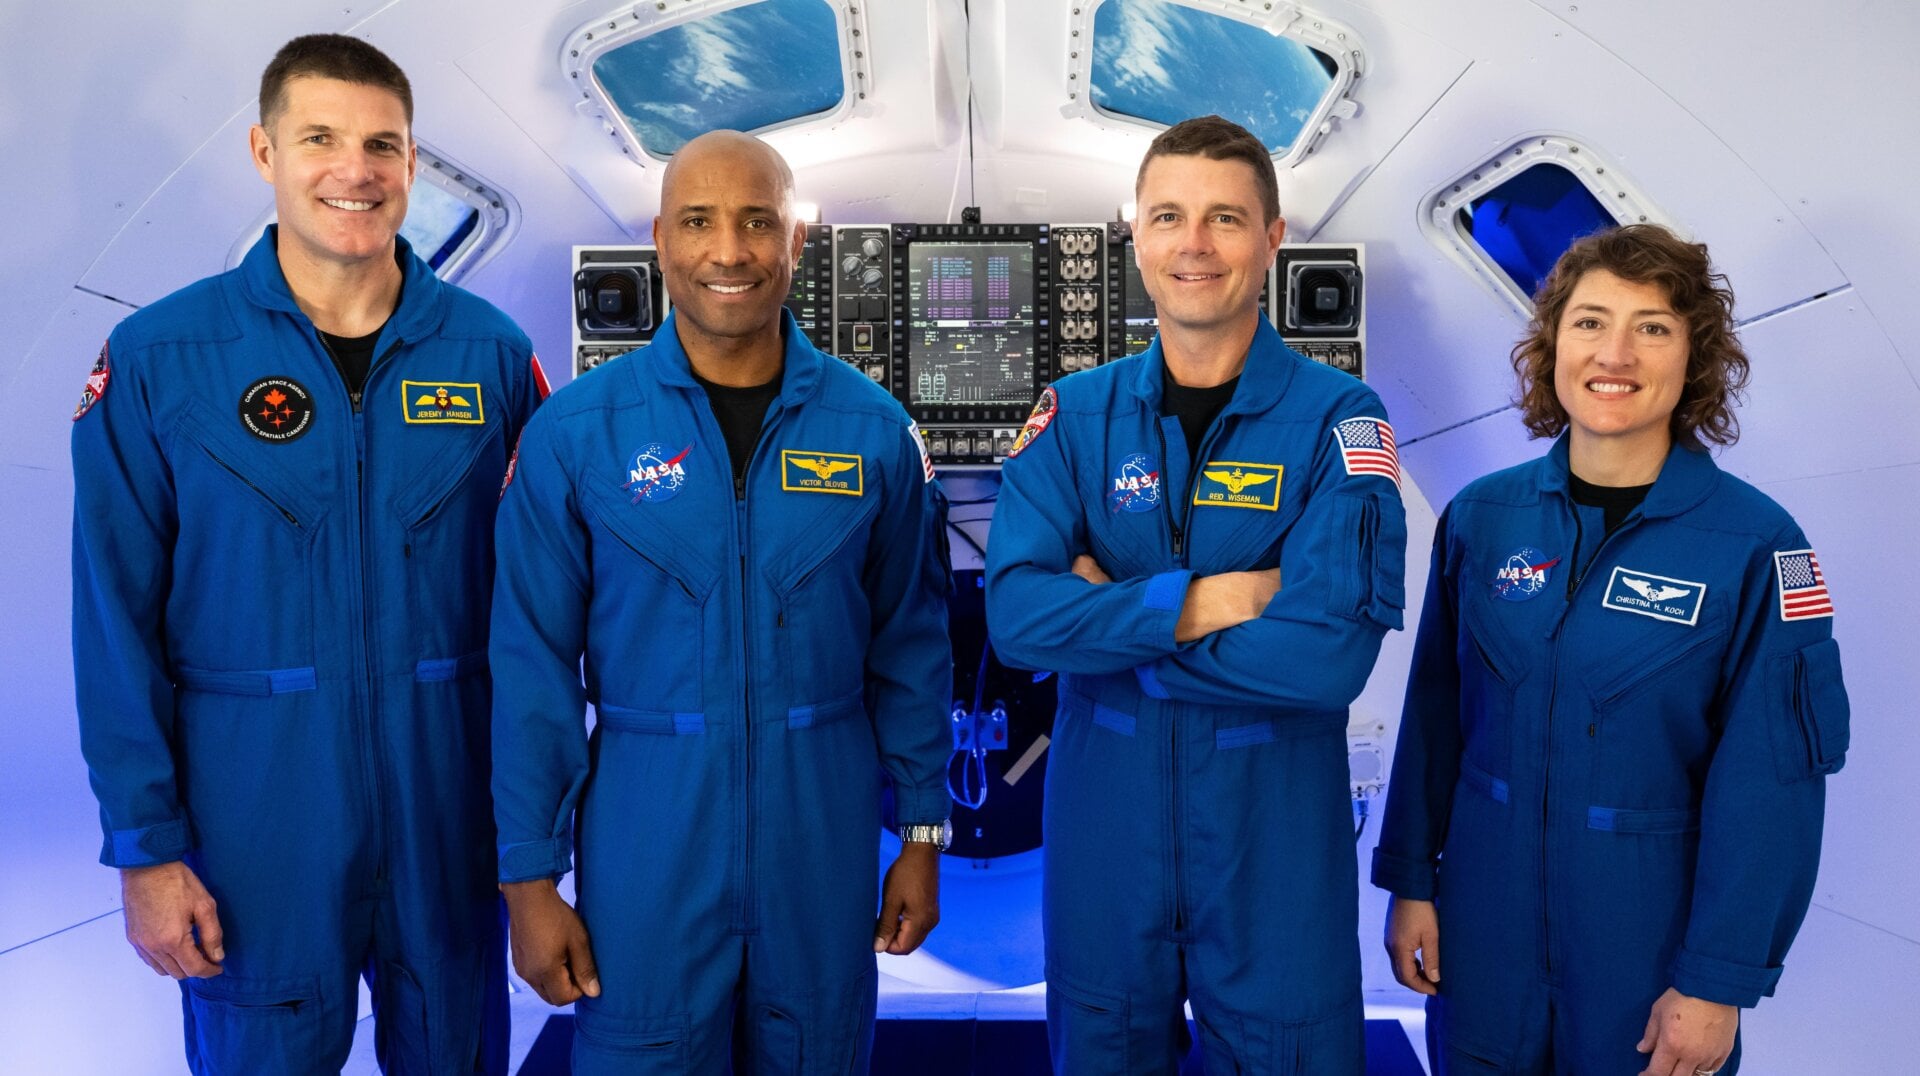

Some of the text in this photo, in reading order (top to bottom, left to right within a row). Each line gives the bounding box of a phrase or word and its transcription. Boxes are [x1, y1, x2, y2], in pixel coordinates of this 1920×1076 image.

[245, 382, 267, 402] CANADIAN
[288, 383, 306, 399] AGENCY
[417, 410, 472, 419] JEREMY HANSEN
[244, 413, 259, 433] AGENCE
[259, 430, 285, 439] SPATIALE
[630, 463, 685, 482] NASA
[825, 480, 848, 488] GLOVER
[1228, 494, 1260, 503] WISEMAN
[1497, 567, 1545, 582] NASA
[1616, 595, 1685, 616] CHRISTINA H. KOCH
